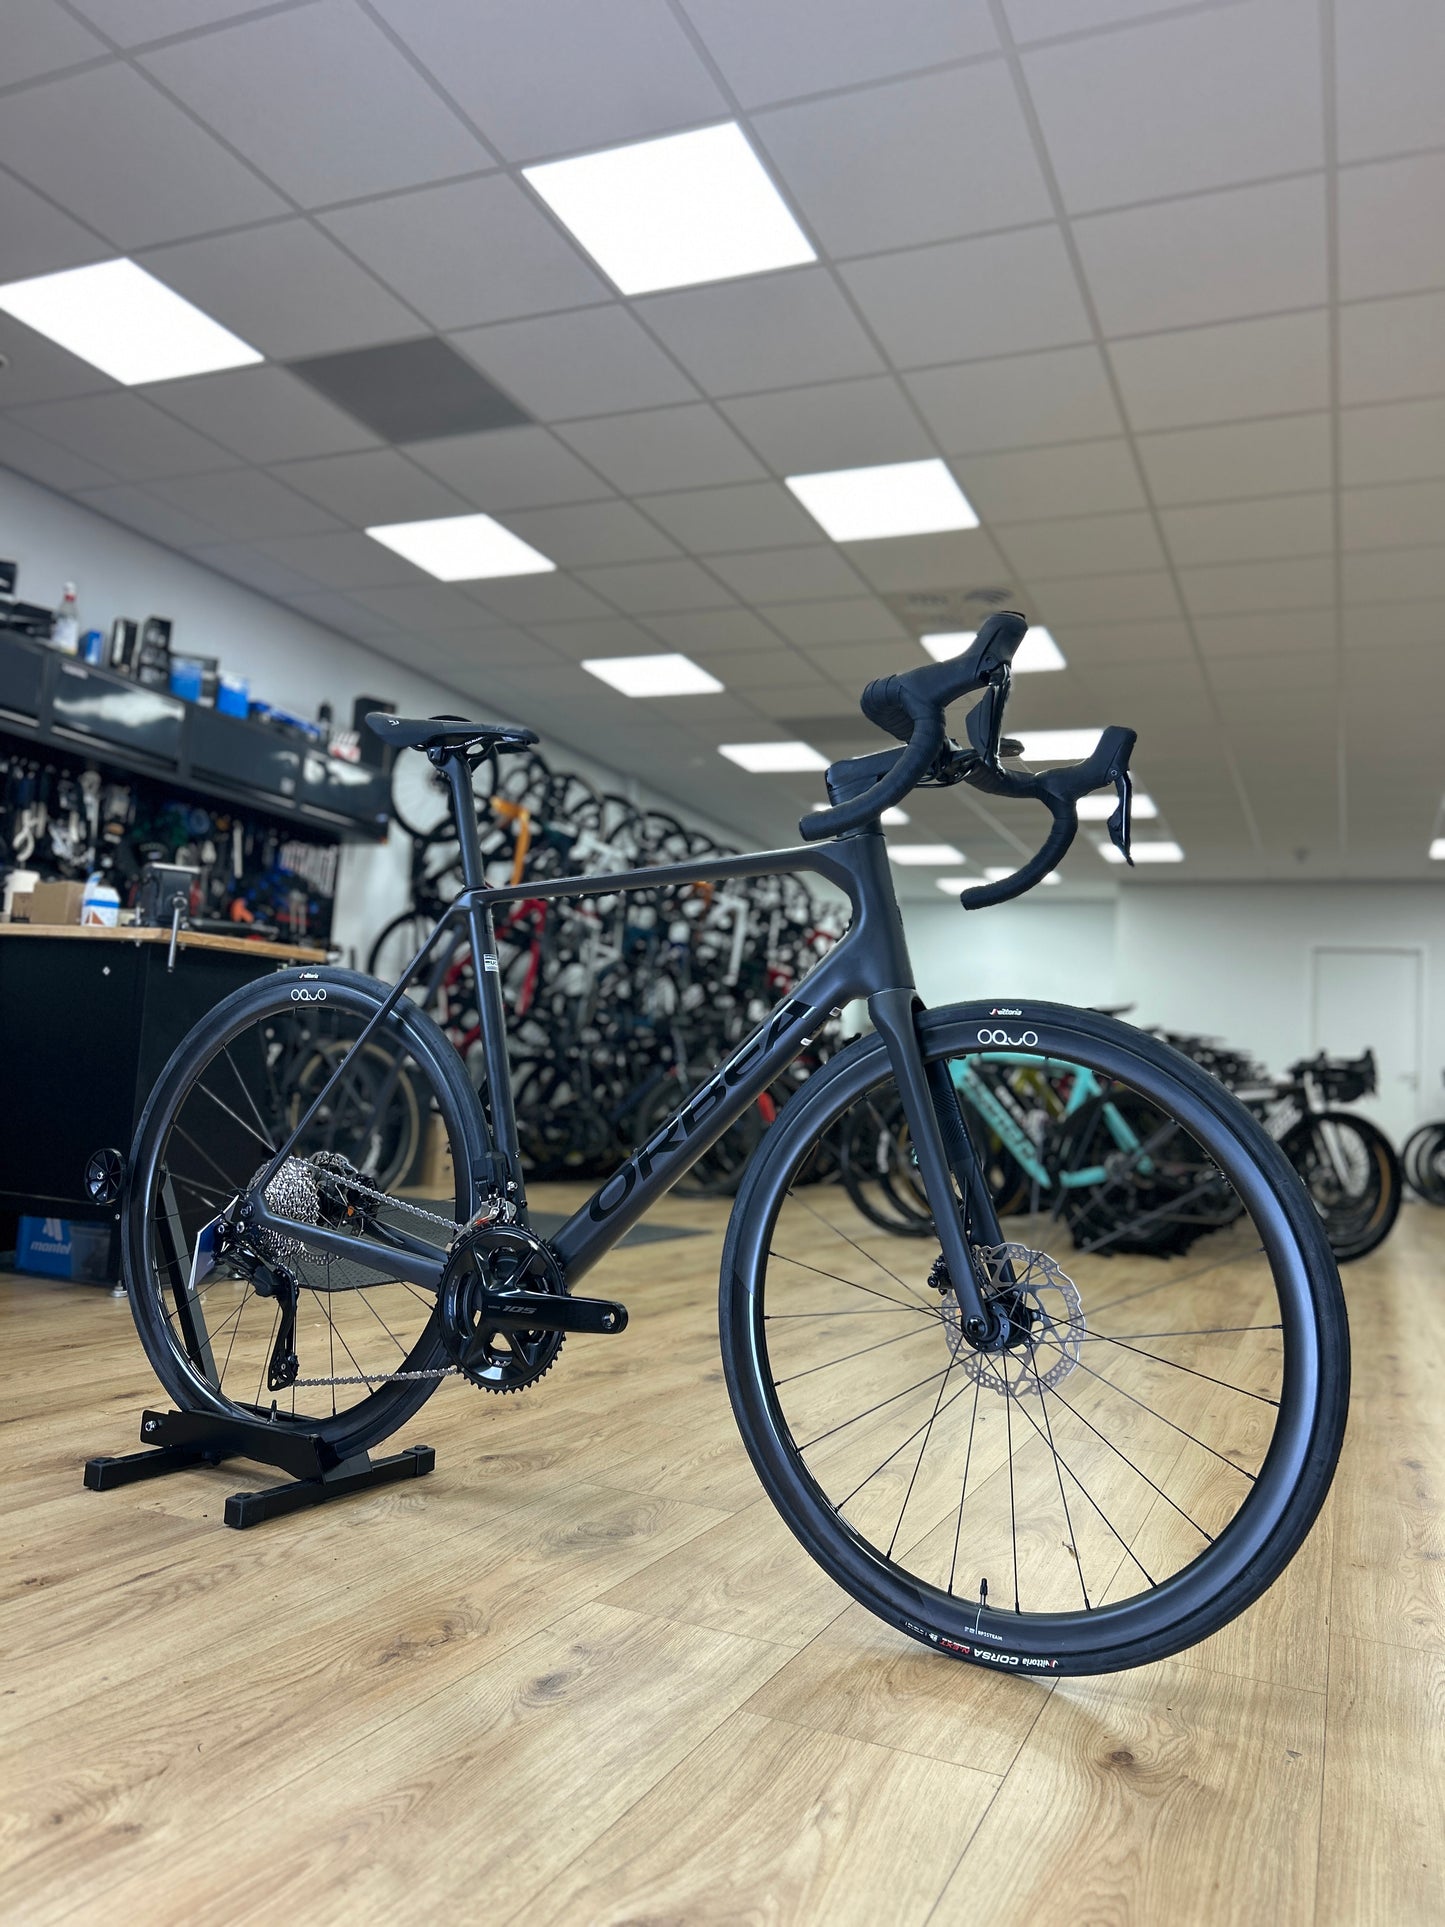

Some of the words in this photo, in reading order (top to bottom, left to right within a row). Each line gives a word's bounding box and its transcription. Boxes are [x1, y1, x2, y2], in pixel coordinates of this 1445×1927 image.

[588, 998, 817, 1222] ORBEA
[502, 1304, 537, 1315] 105
[974, 1648, 1019, 1665] CORSA
[1022, 1657, 1053, 1668] vittoria
